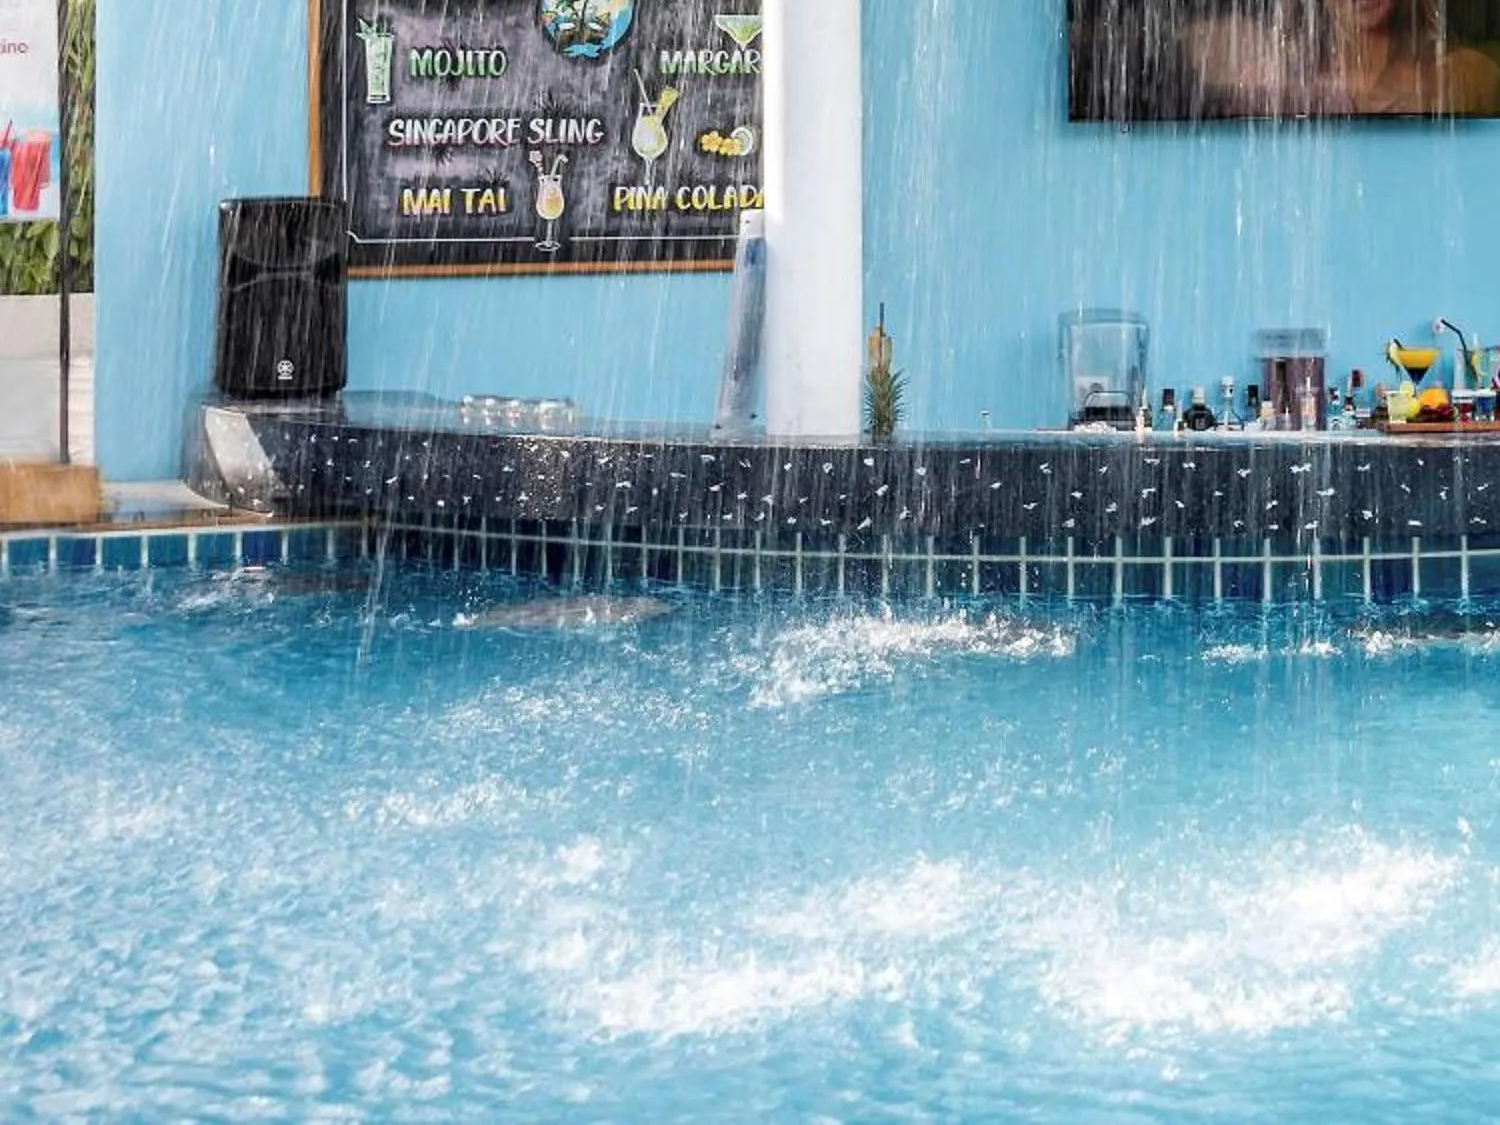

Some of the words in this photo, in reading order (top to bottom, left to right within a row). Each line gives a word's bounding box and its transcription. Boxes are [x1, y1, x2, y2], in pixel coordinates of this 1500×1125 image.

[410, 48, 507, 76] MOJITO
[660, 49, 763, 75] MARGAR
[388, 117, 521, 146] SINGAPORE
[527, 117, 605, 145] SLING
[402, 187, 451, 215] MAI
[460, 187, 507, 214] TAI
